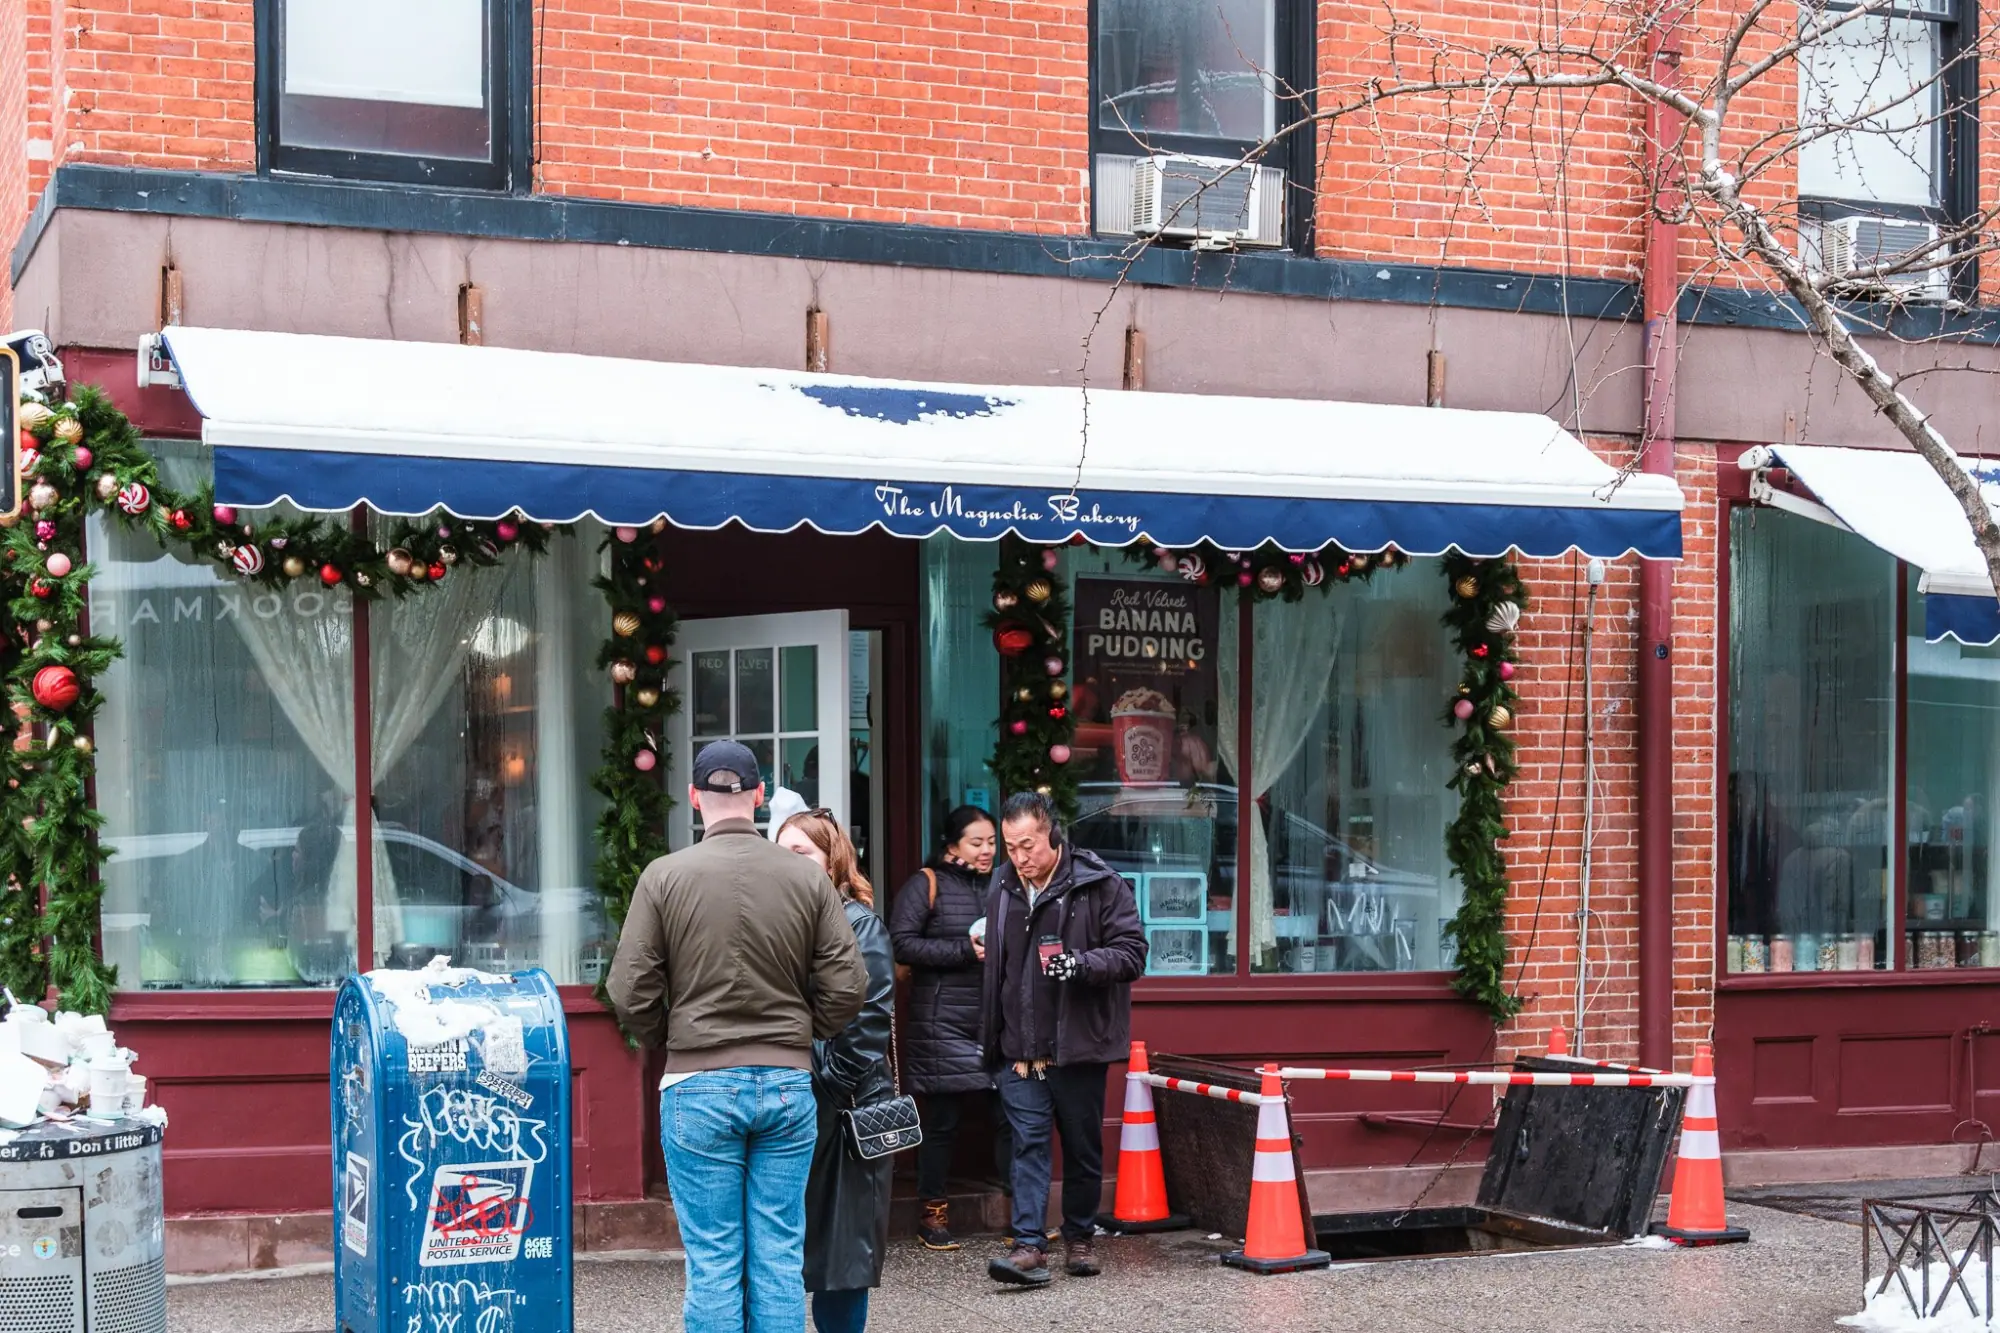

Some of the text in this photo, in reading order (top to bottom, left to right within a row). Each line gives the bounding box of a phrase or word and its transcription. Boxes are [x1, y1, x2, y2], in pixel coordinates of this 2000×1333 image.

[874, 481, 1141, 532] The Magnolia Bakery
[1110, 588, 1188, 608] Red Velvet
[1099, 607, 1196, 634] BANANA
[1088, 634, 1205, 660] PUDDING
[408, 1053, 466, 1071] BEEPERS
[480, 1071, 532, 1102] POSTERBOY
[115, 1134, 144, 1149] litter
[430, 1234, 509, 1247] UNITED STATES
[427, 1245, 512, 1259] POSTAL SERVICE
